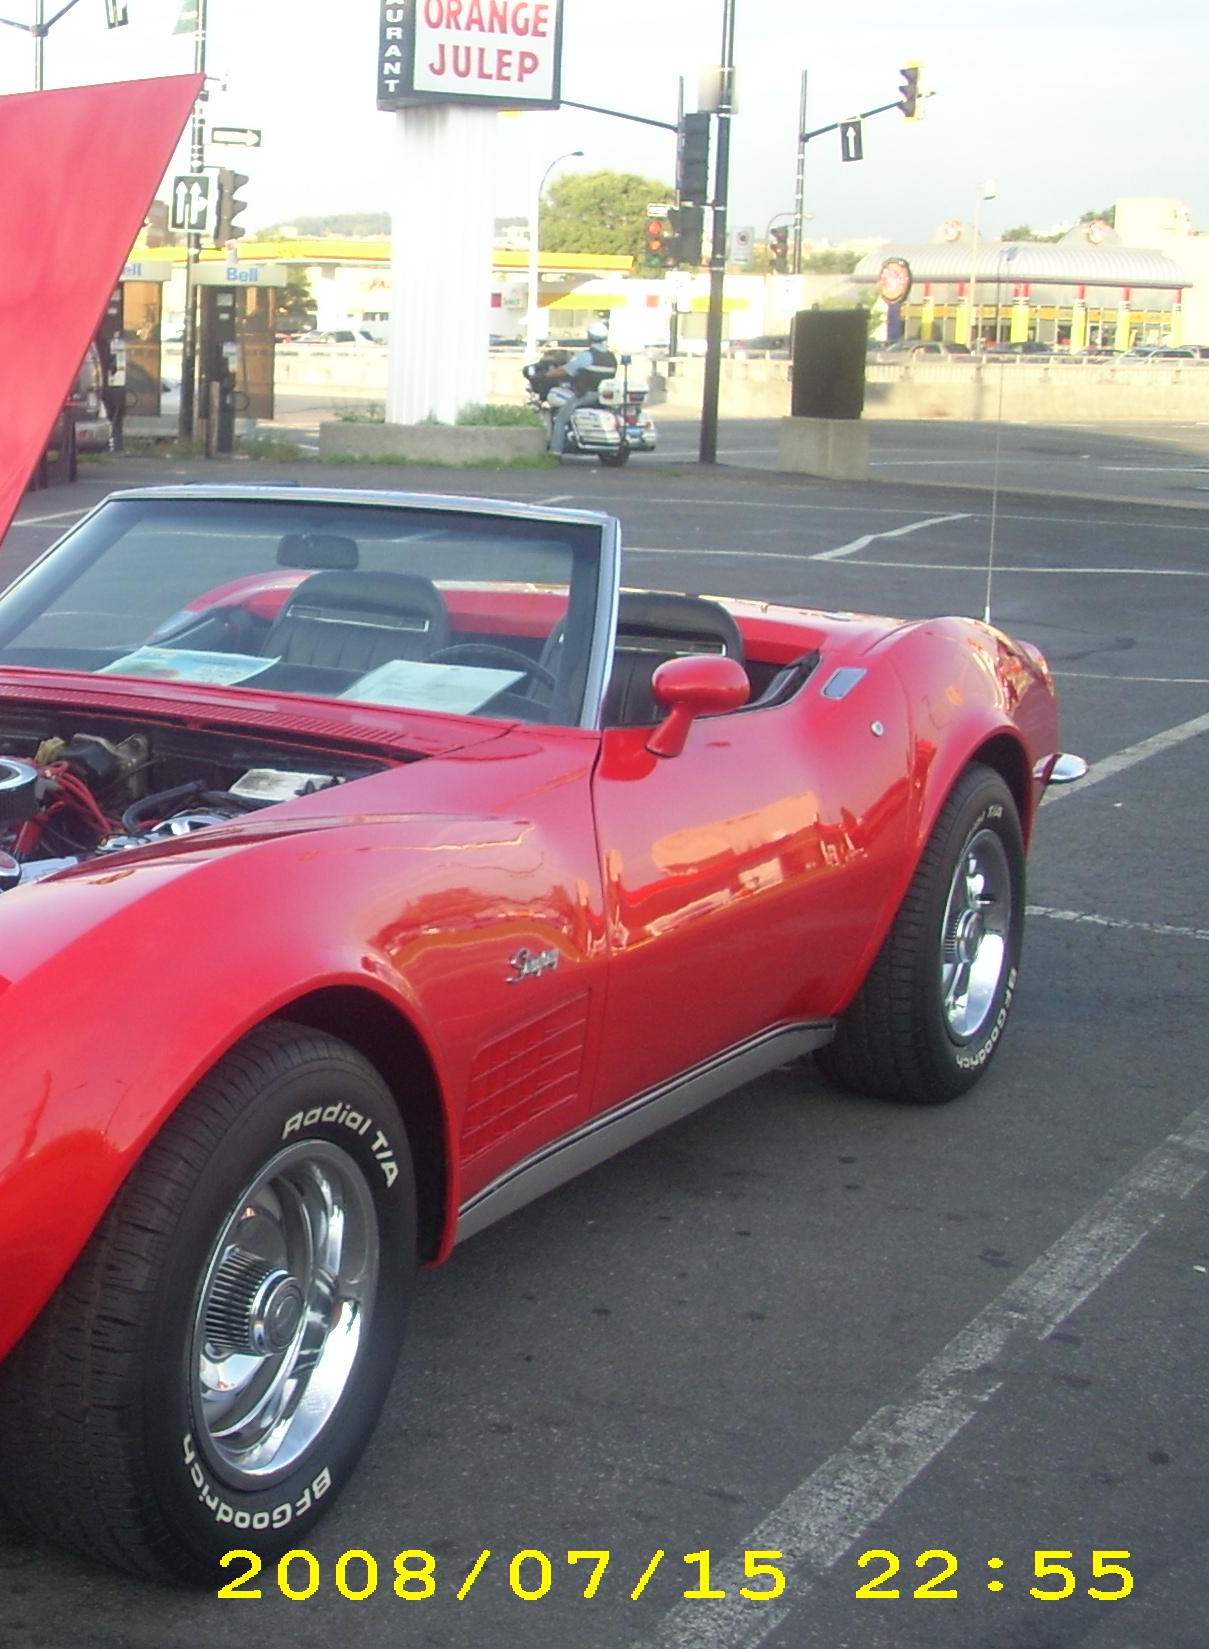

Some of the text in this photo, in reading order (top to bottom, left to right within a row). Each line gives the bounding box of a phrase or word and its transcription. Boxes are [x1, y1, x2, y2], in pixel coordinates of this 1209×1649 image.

[424, 0, 549, 37] ORANGE
[428, 43, 539, 82] JULEP
[123, 262, 142, 276] ell
[226, 267, 258, 282] Bell
[956, 967, 1017, 1070] BFGoodrich
[282, 1102, 399, 1188] Radial T/A
[182, 1433, 332, 1529] BFGoodrich
